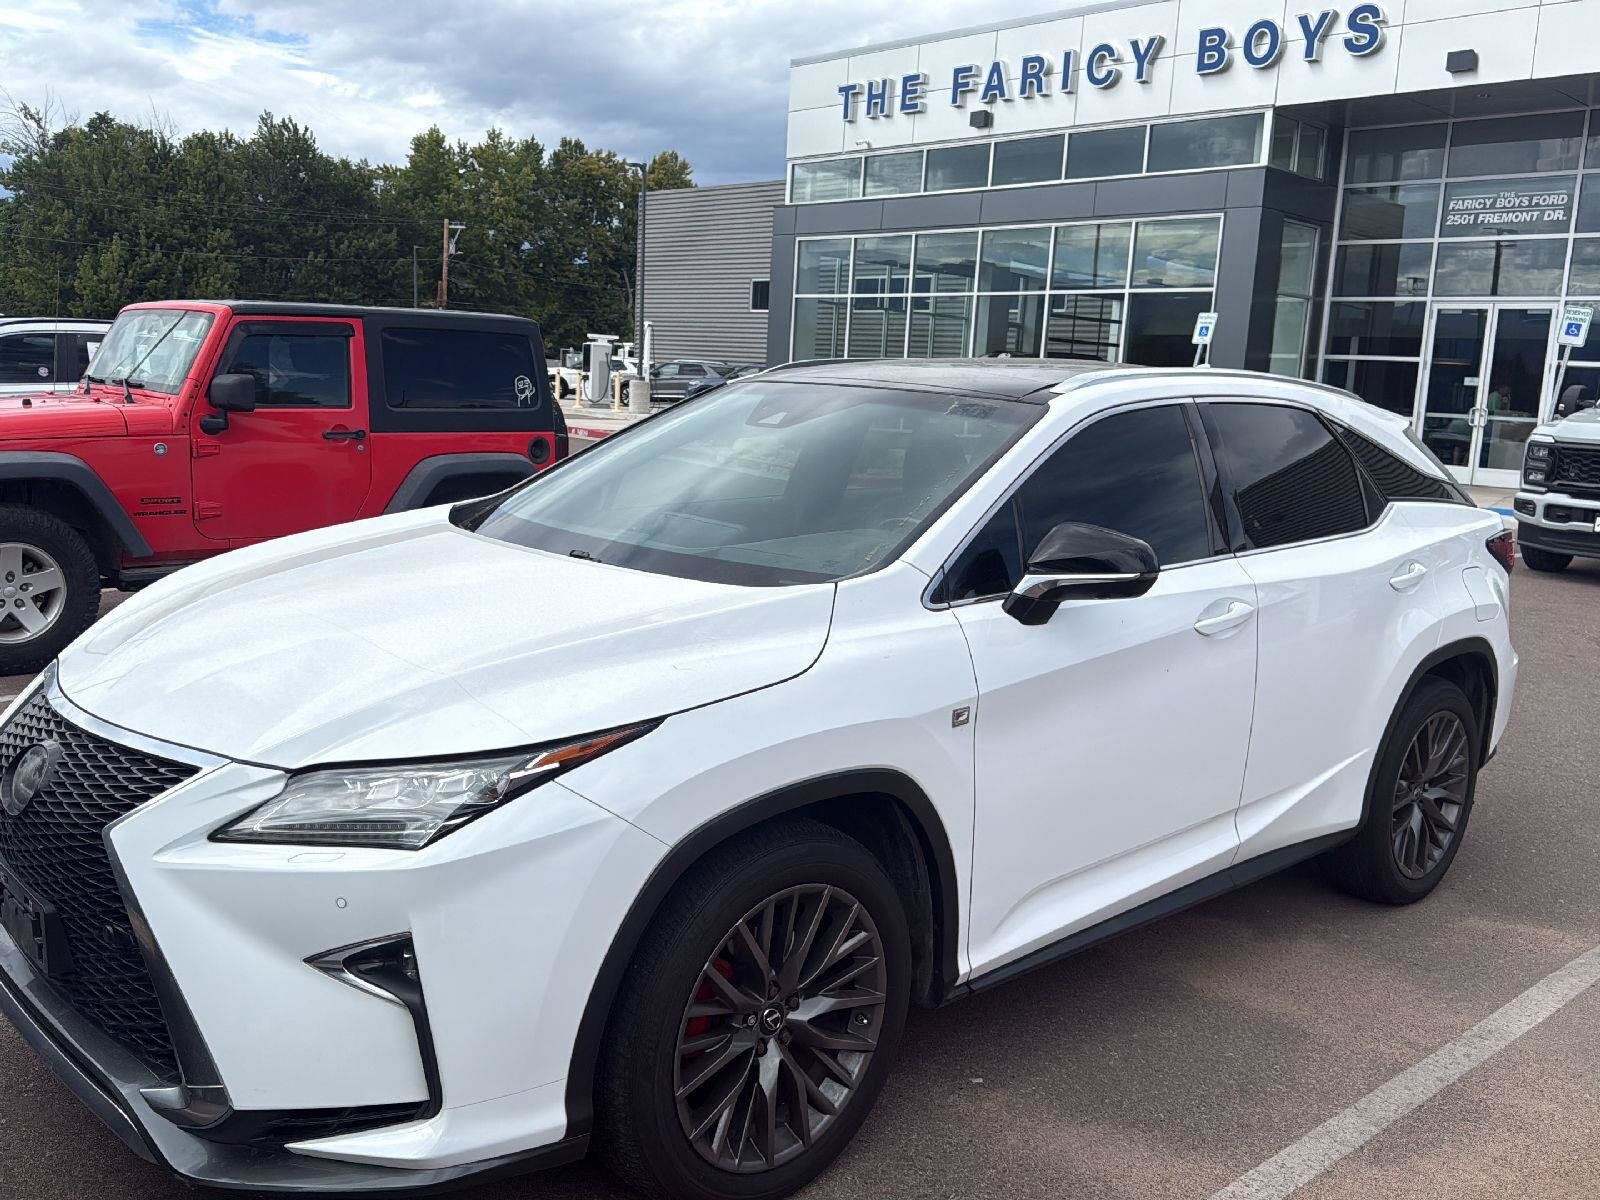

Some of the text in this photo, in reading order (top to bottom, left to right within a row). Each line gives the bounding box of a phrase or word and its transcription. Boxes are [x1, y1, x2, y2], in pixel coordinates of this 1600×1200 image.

[837, 2, 1388, 124] THE FARICY BOYS
[1449, 194, 1568, 210] FARICY BOYS FORD
[1445, 209, 1568, 226] 2501 FREMONT DR.
